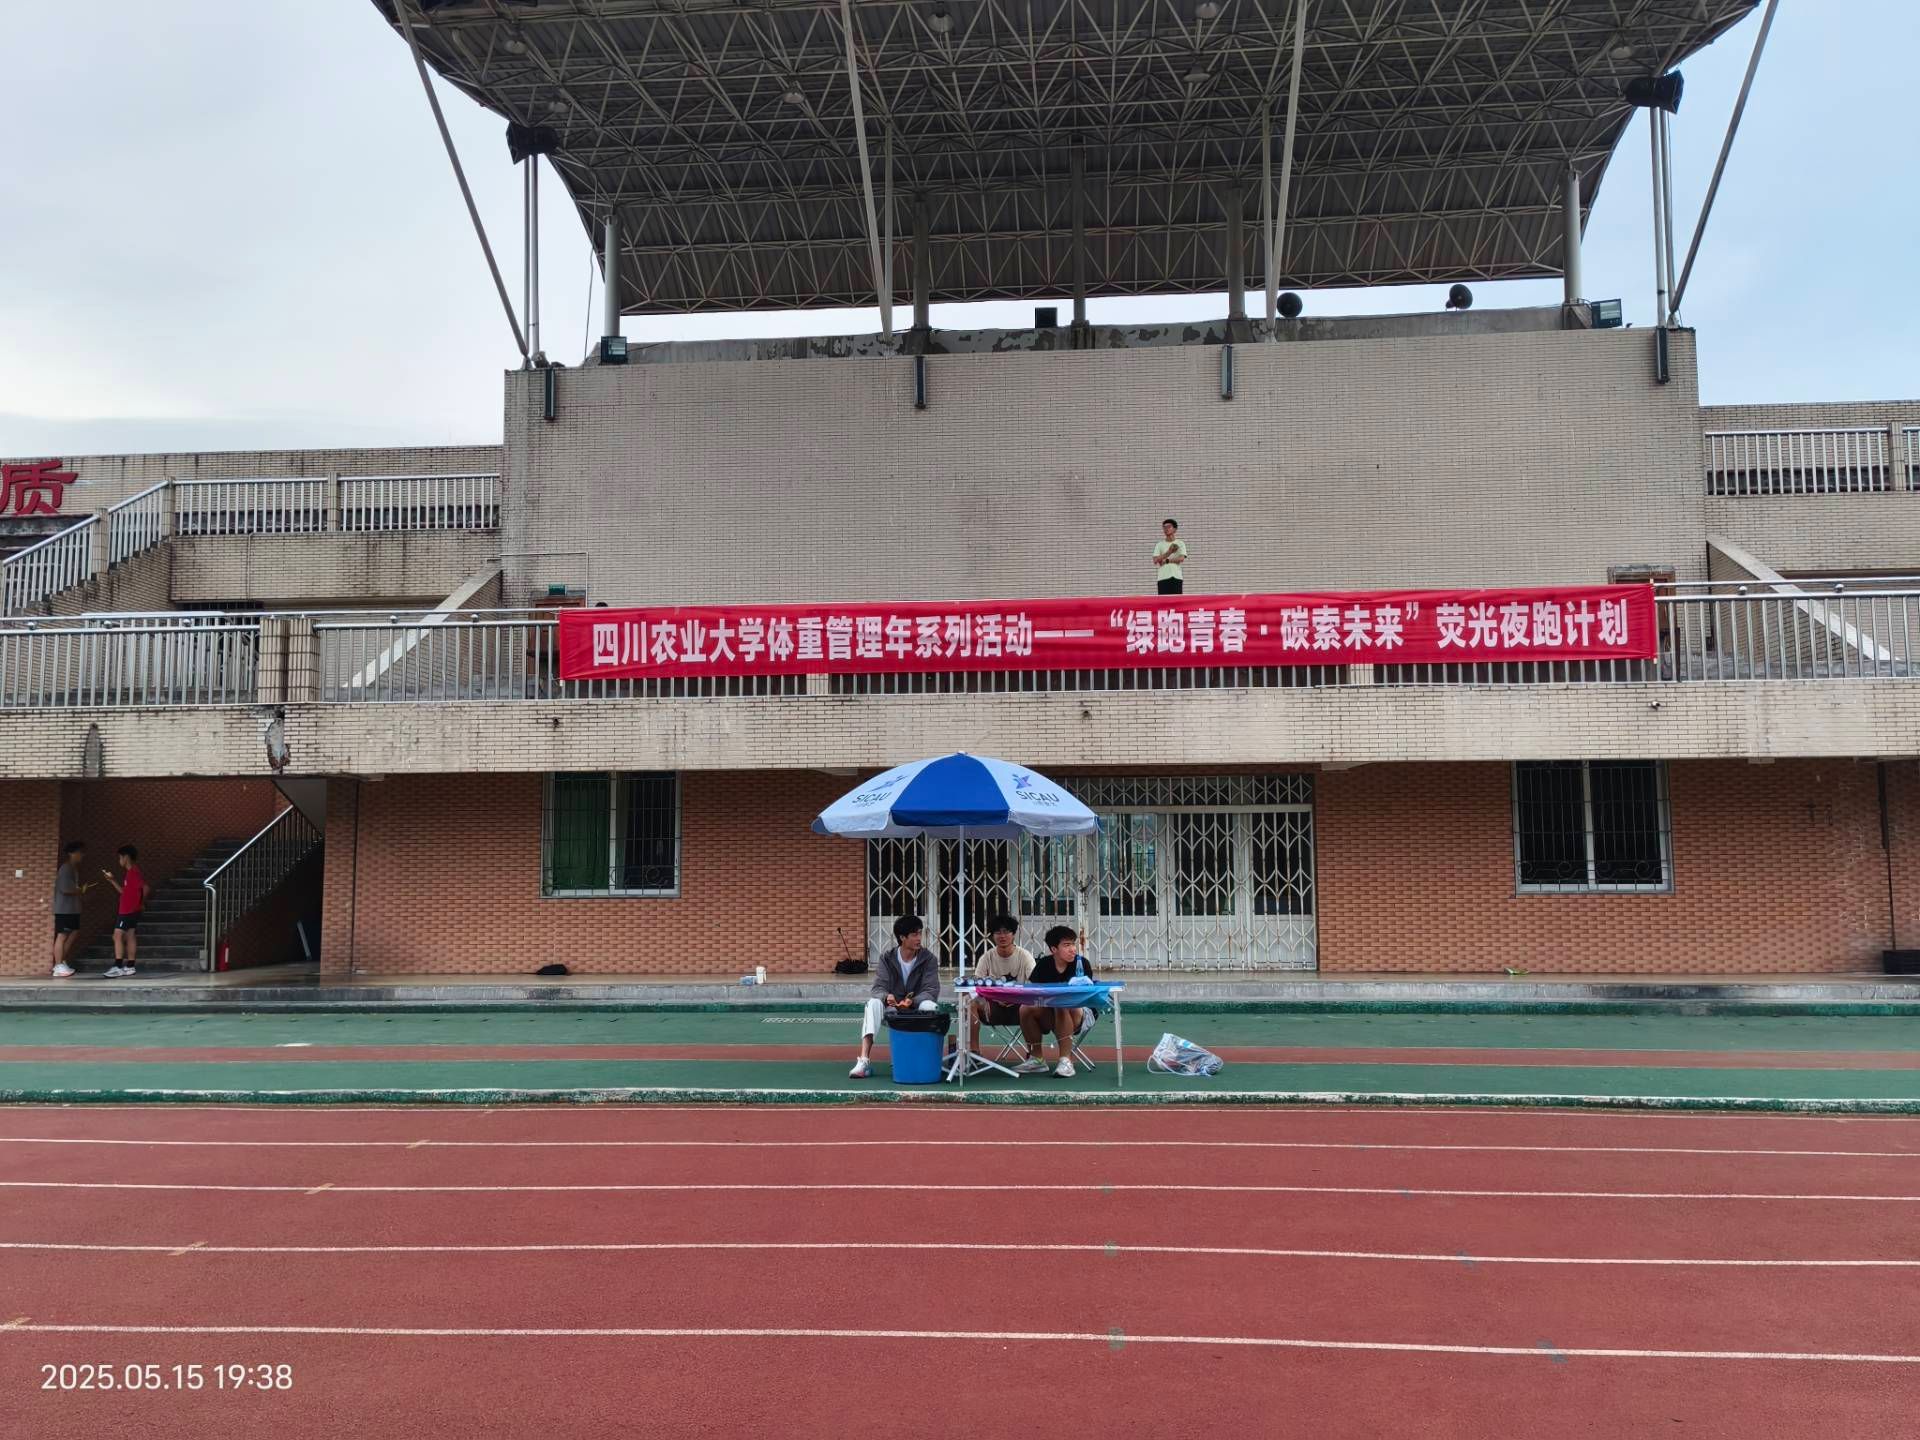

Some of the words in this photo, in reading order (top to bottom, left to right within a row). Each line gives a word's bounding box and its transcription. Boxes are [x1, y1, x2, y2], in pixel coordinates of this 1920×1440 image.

[0, 460, 79, 515] 质
[852, 791, 892, 804] SICAU
[1015, 790, 1060, 803] SICAU
